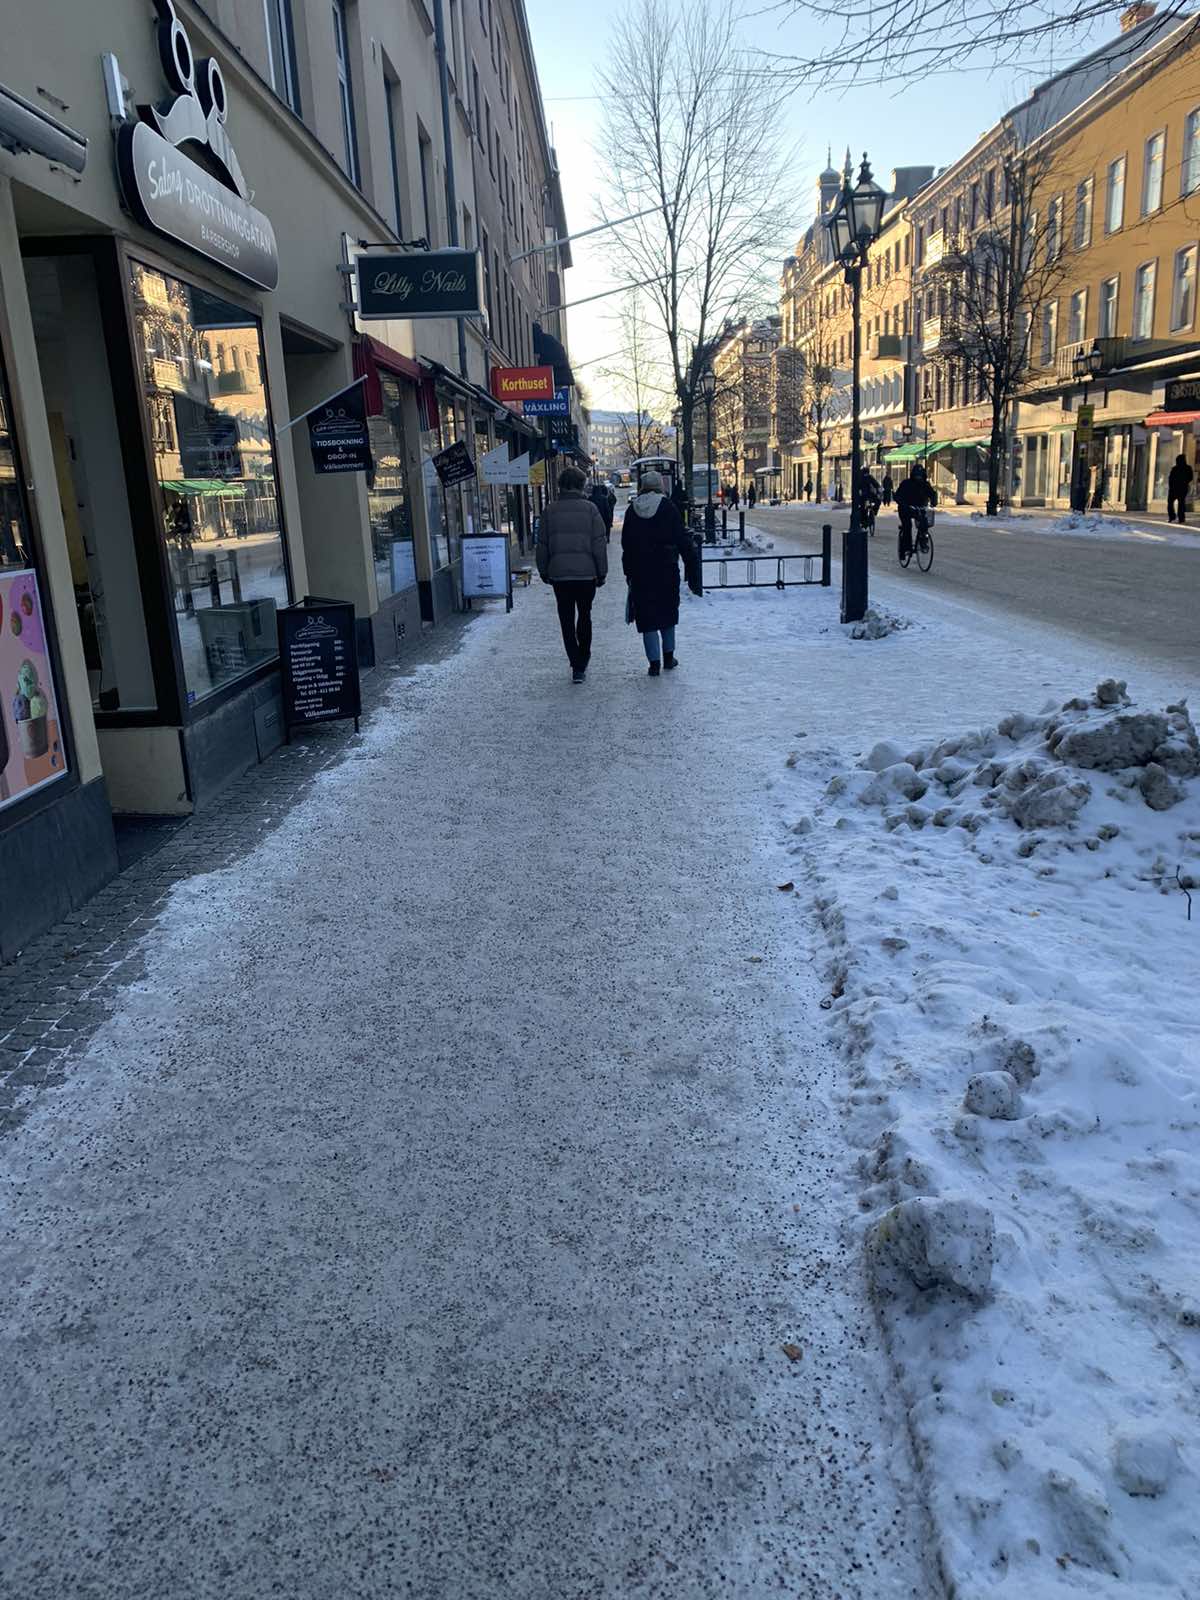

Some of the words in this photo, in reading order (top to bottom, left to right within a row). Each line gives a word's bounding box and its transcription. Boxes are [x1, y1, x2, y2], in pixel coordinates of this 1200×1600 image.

[185, 177, 273, 256] DROTTNINGGATAN
[371, 271, 414, 302] Lilly
[420, 269, 467, 293] Nails
[502, 377, 548, 391] Korthuset
[316, 437, 365, 447] TIDSBOKNING
